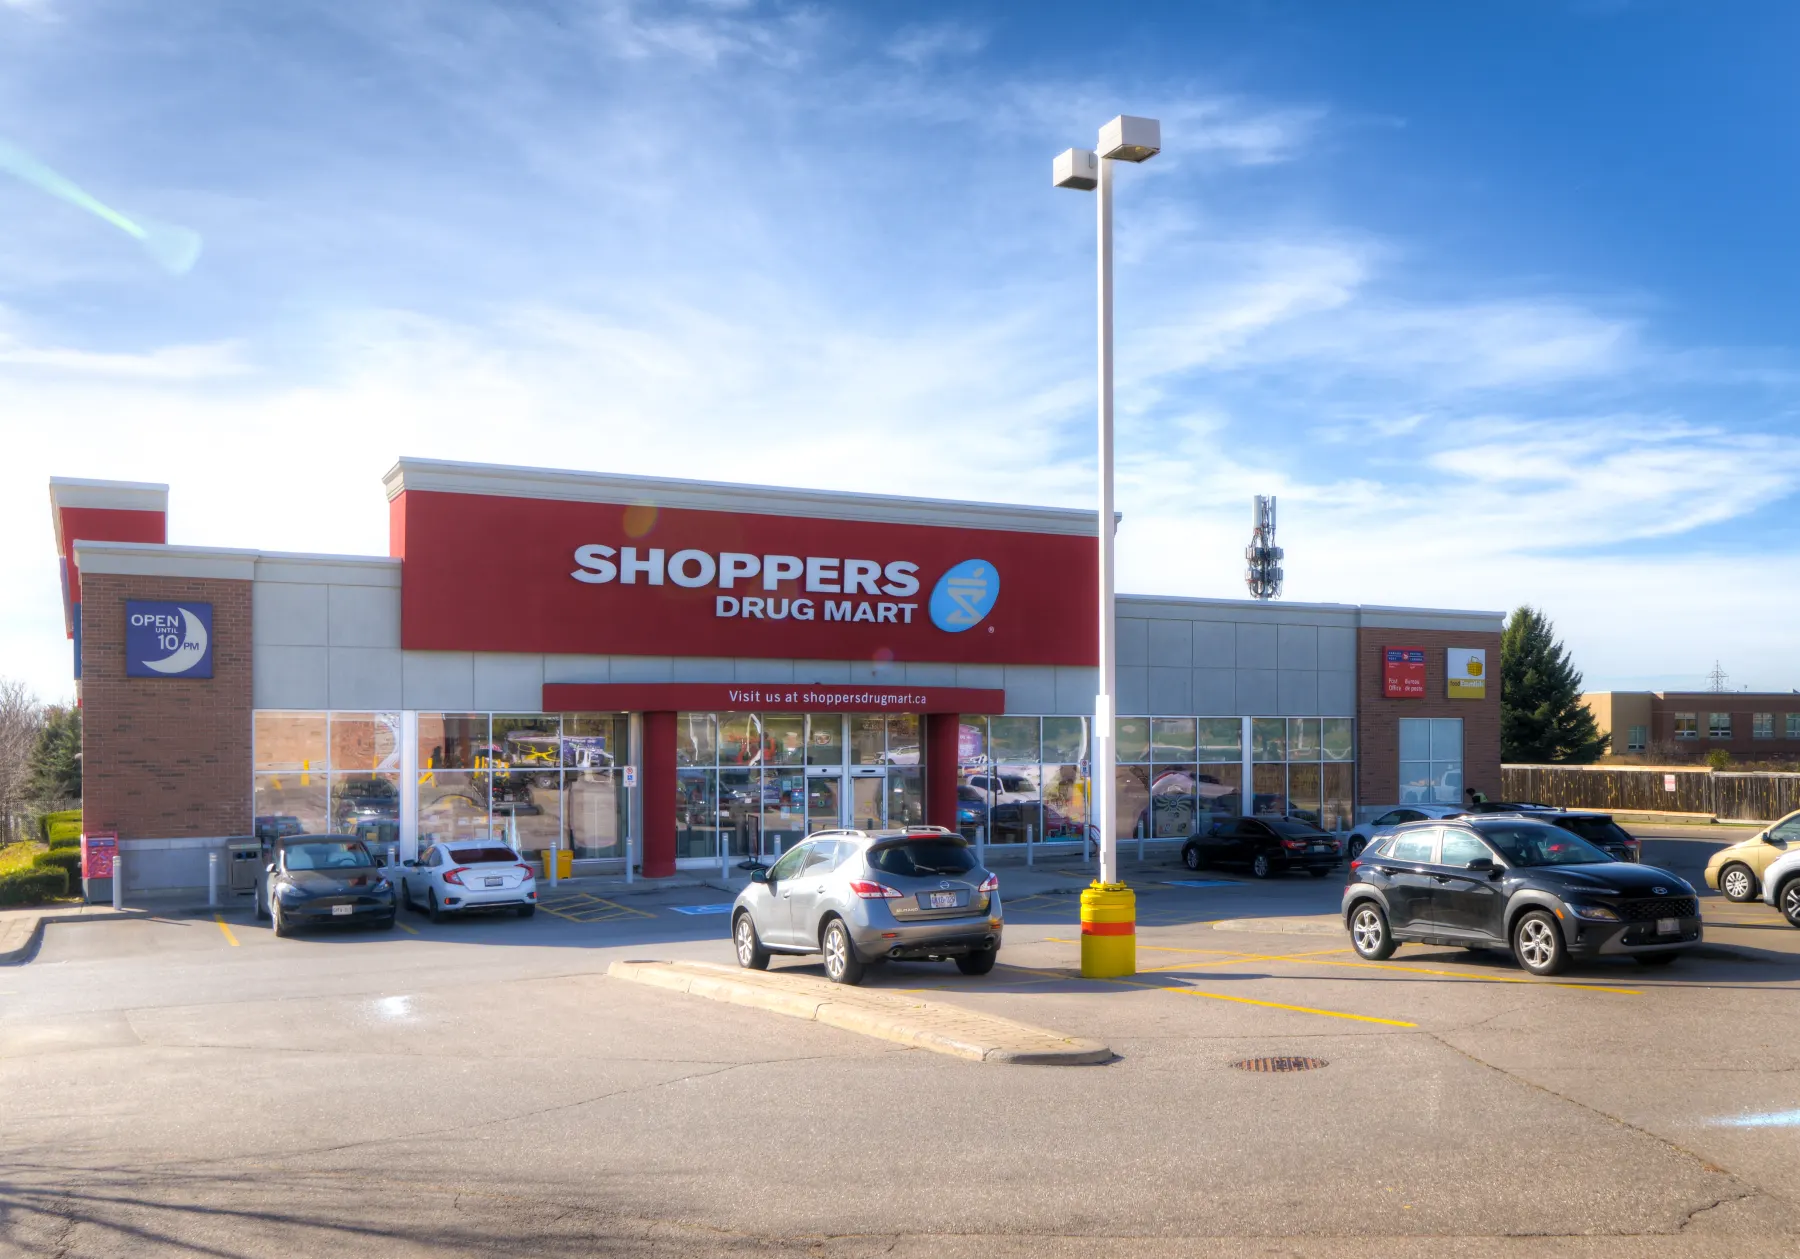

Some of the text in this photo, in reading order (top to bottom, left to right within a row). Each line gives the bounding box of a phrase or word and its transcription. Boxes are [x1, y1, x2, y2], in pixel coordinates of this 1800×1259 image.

[570, 543, 921, 597] SHOPPERS
[715, 595, 919, 624] DRUG MART
[131, 614, 178, 627] OPEN
[157, 634, 199, 650] 10 PM
[729, 690, 927, 708] Visit us at shoppersdrugmart.ca
